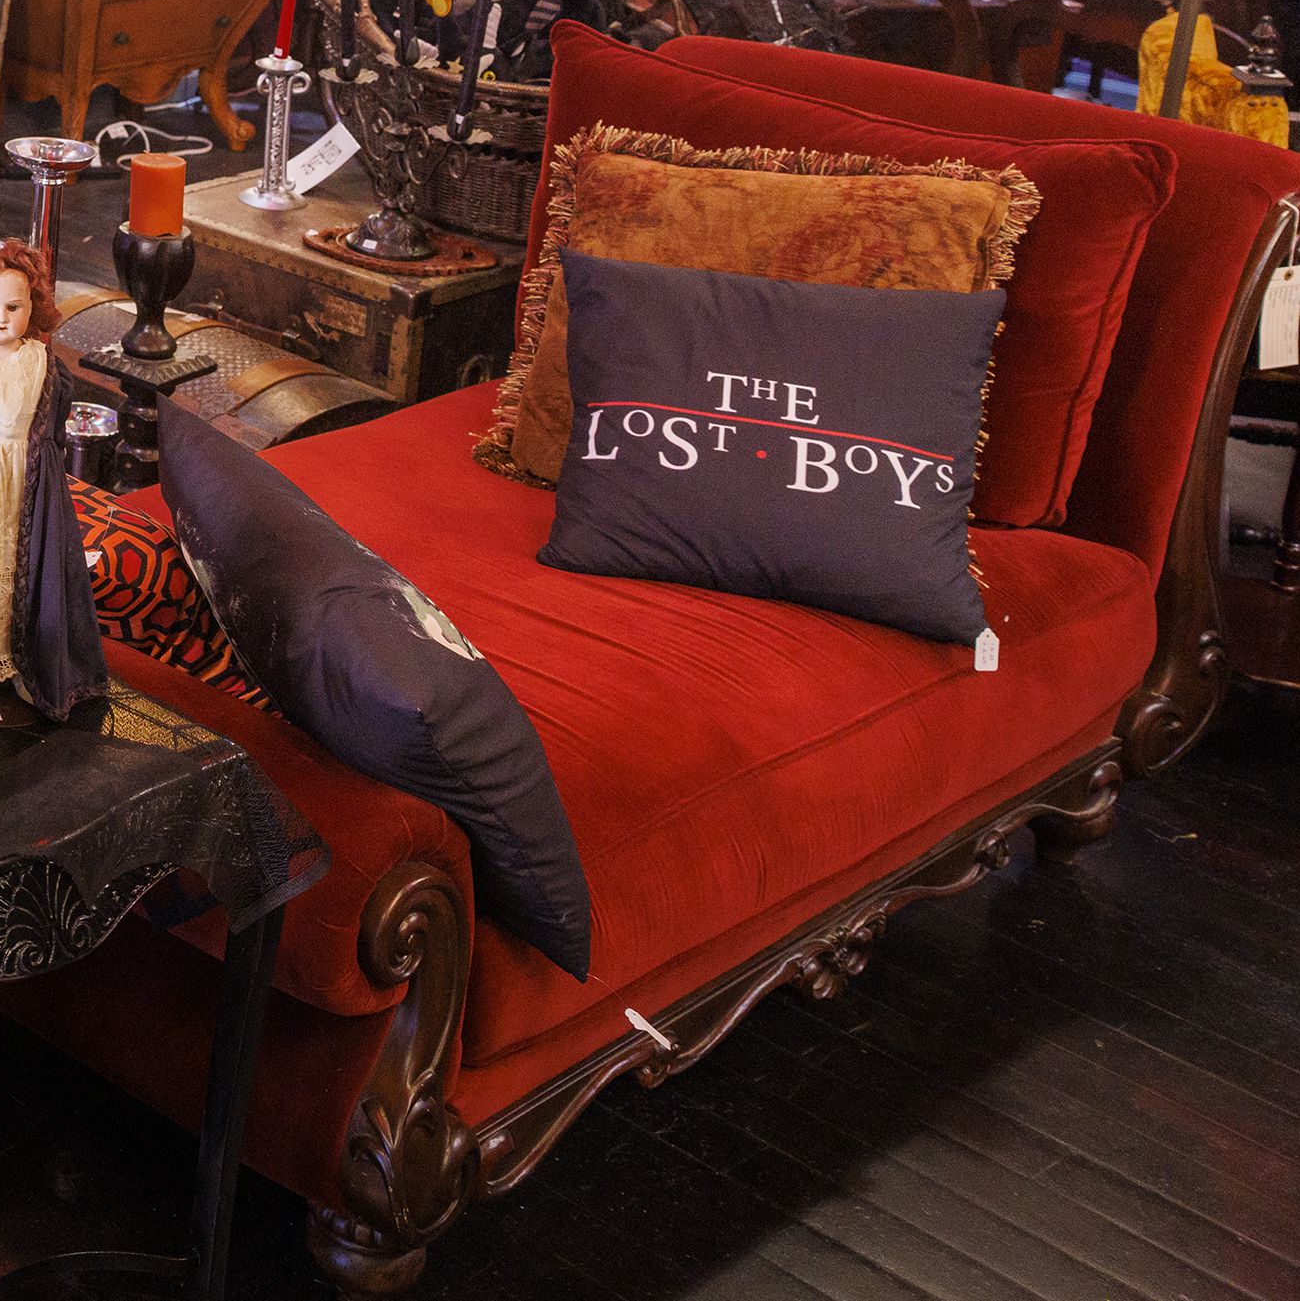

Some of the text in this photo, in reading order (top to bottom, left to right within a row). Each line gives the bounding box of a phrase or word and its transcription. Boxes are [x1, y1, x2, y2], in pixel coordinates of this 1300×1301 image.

[706, 371, 820, 425] THE
[582, 409, 954, 509] LOST BOYS
